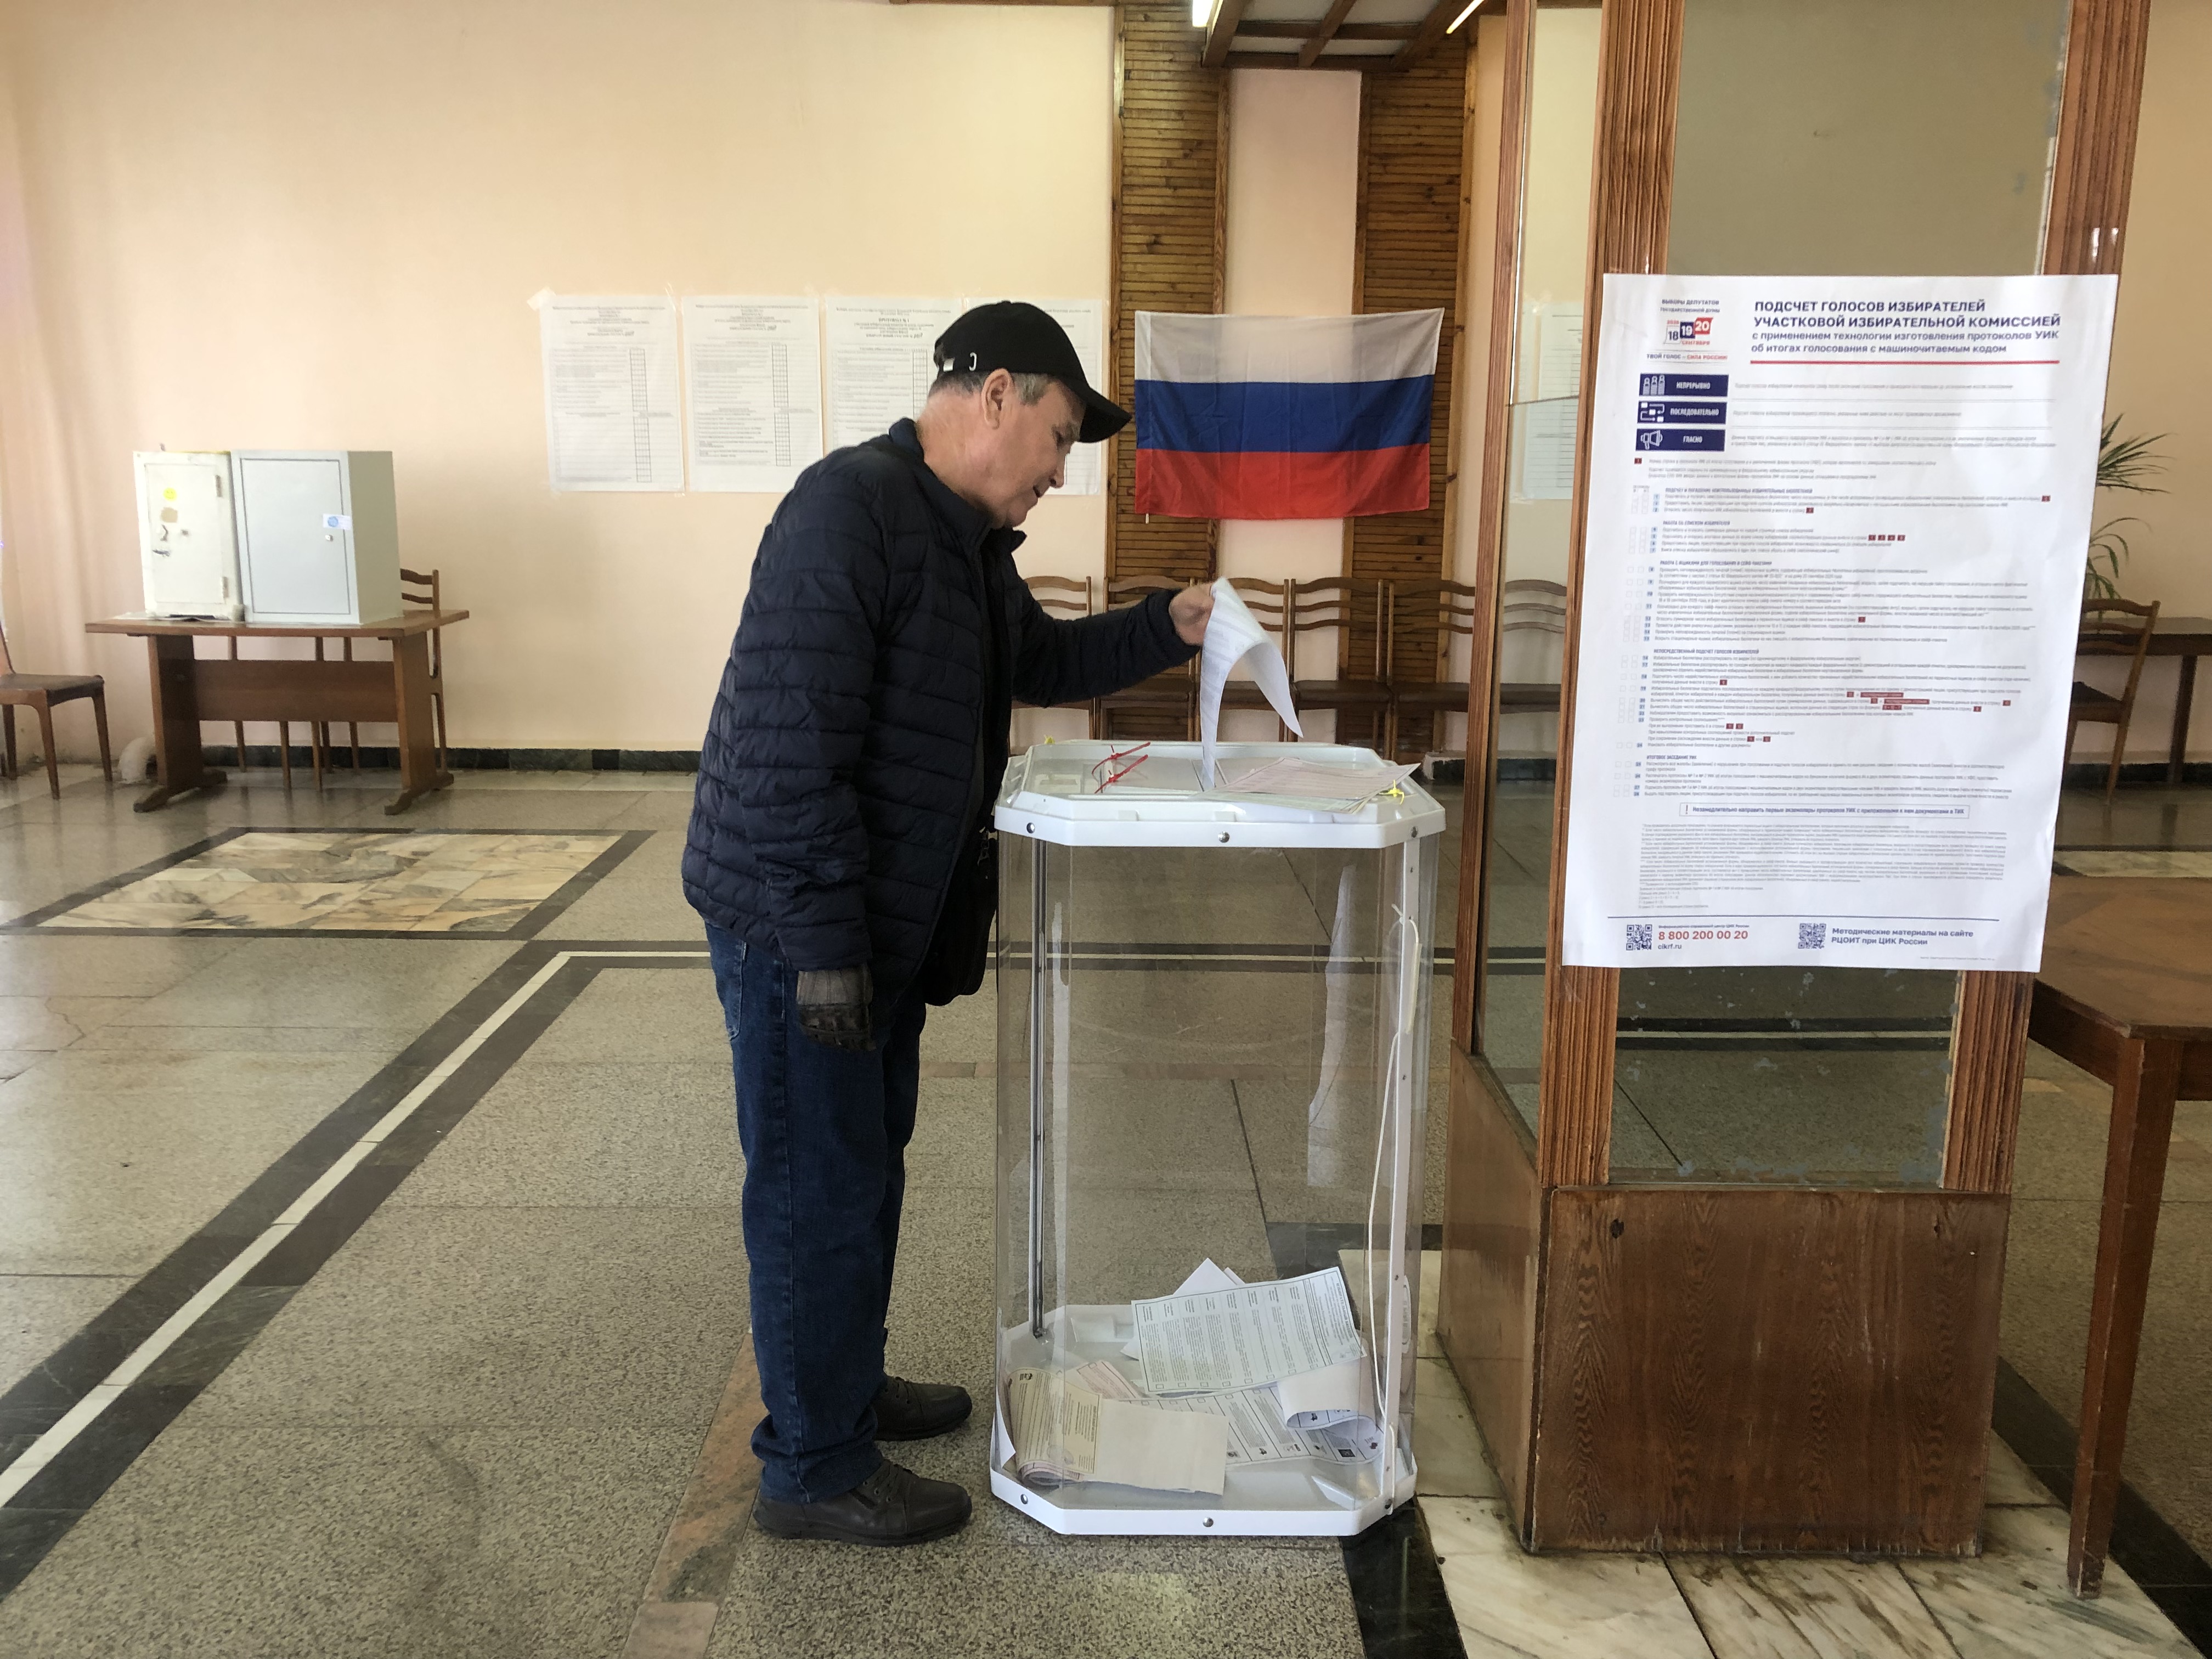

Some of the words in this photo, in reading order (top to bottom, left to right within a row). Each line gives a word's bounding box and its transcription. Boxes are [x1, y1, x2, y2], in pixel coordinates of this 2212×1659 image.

[1755, 301, 1818, 313] ПОДСЧЕТ
[1821, 302, 1884, 312] ГОЛОСОВ
[1888, 299, 1985, 312] ИЗБИРАТЕЛЕЙ
[1754, 315, 1844, 328] УЧАСТКОВОЙ
[1848, 315, 1965, 328] ИЗБИРАТЕЛЬНОЙ
[1969, 313, 2061, 327] КОМИССИЕЙ
[1681, 325, 1692, 336] 19
[1695, 321, 1709, 331] 20
[1668, 331, 1679, 341] 18
[1967, 333, 2032, 342] протоколов
[2035, 331, 2059, 339] УИК
[1751, 343, 1764, 352] об
[1677, 381, 1711, 390] НЕПРЕРЫВНО
[1658, 932, 1665, 940] 8
[1668, 931, 1689, 940] 800
[1692, 931, 1713, 939] 200
[1717, 930, 1731, 939] 00
[1734, 930, 1748, 939] 20
